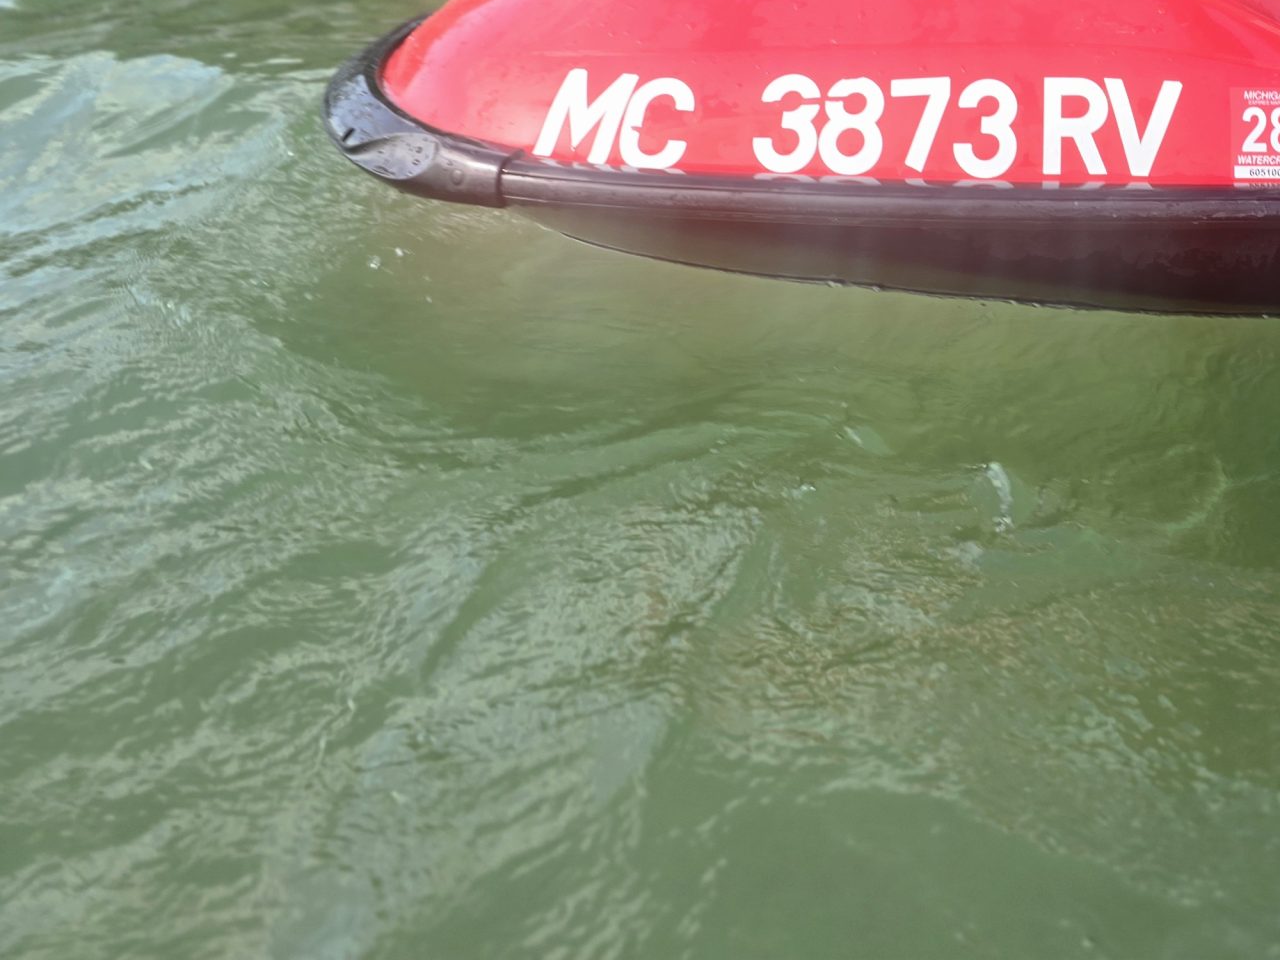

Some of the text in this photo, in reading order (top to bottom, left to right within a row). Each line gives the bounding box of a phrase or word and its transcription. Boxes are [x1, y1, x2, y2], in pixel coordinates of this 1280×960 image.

[532, 68, 1184, 179] MC 3873 RV
